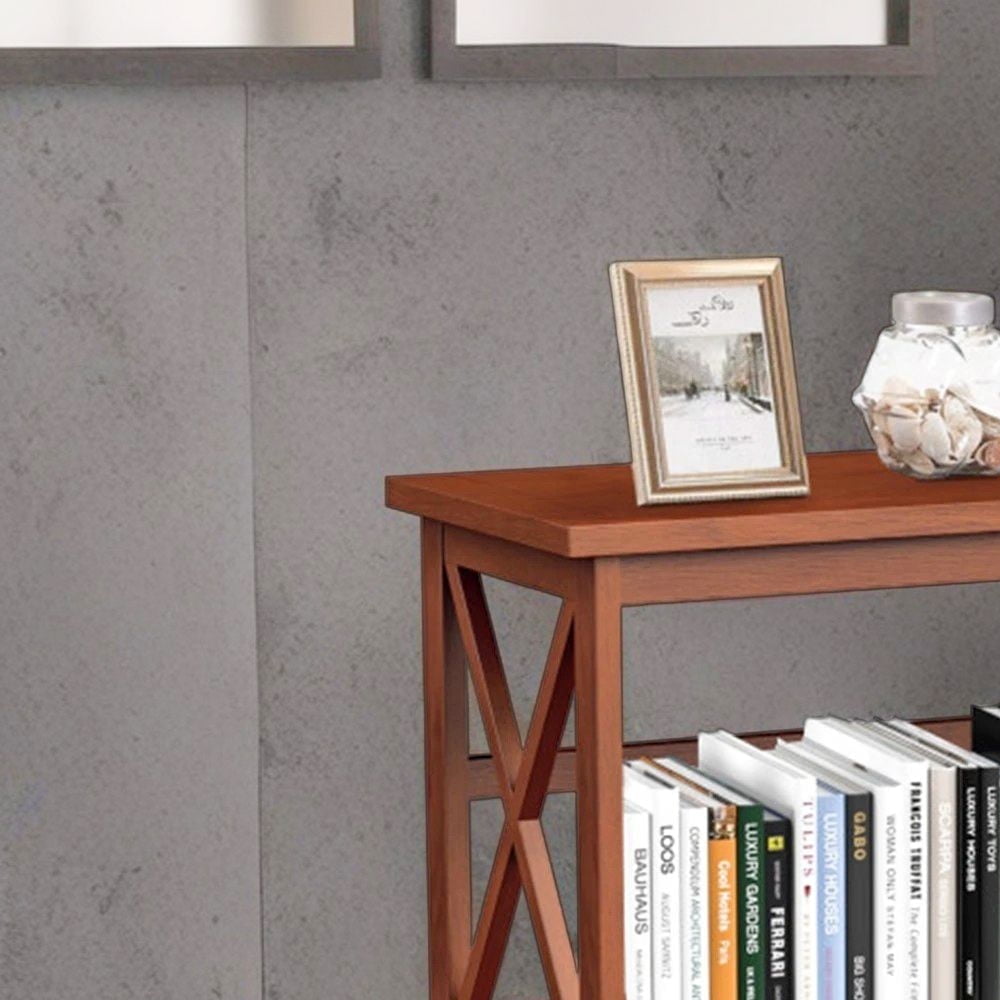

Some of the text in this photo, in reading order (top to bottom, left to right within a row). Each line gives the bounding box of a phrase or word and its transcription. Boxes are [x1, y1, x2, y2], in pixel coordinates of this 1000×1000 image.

[852, 811, 866, 861] GABO
[987, 786, 997, 836] LUXURY
[659, 825, 675, 875] LOOS
[802, 801, 814, 878] TULIPS
[823, 813, 838, 870] LUXURY
[885, 814, 896, 864] WOMAN
[634, 848, 649, 935] BAUHAUS
[718, 860, 731, 888] Cool
[745, 822, 759, 954] LUXURY GARDENS
[885, 868, 896, 902] ONLY
[718, 891, 731, 932] Hotels
[824, 874, 839, 935] HOUSES
[910, 906, 920, 926] The
[770, 907, 786, 978] FERRARI
